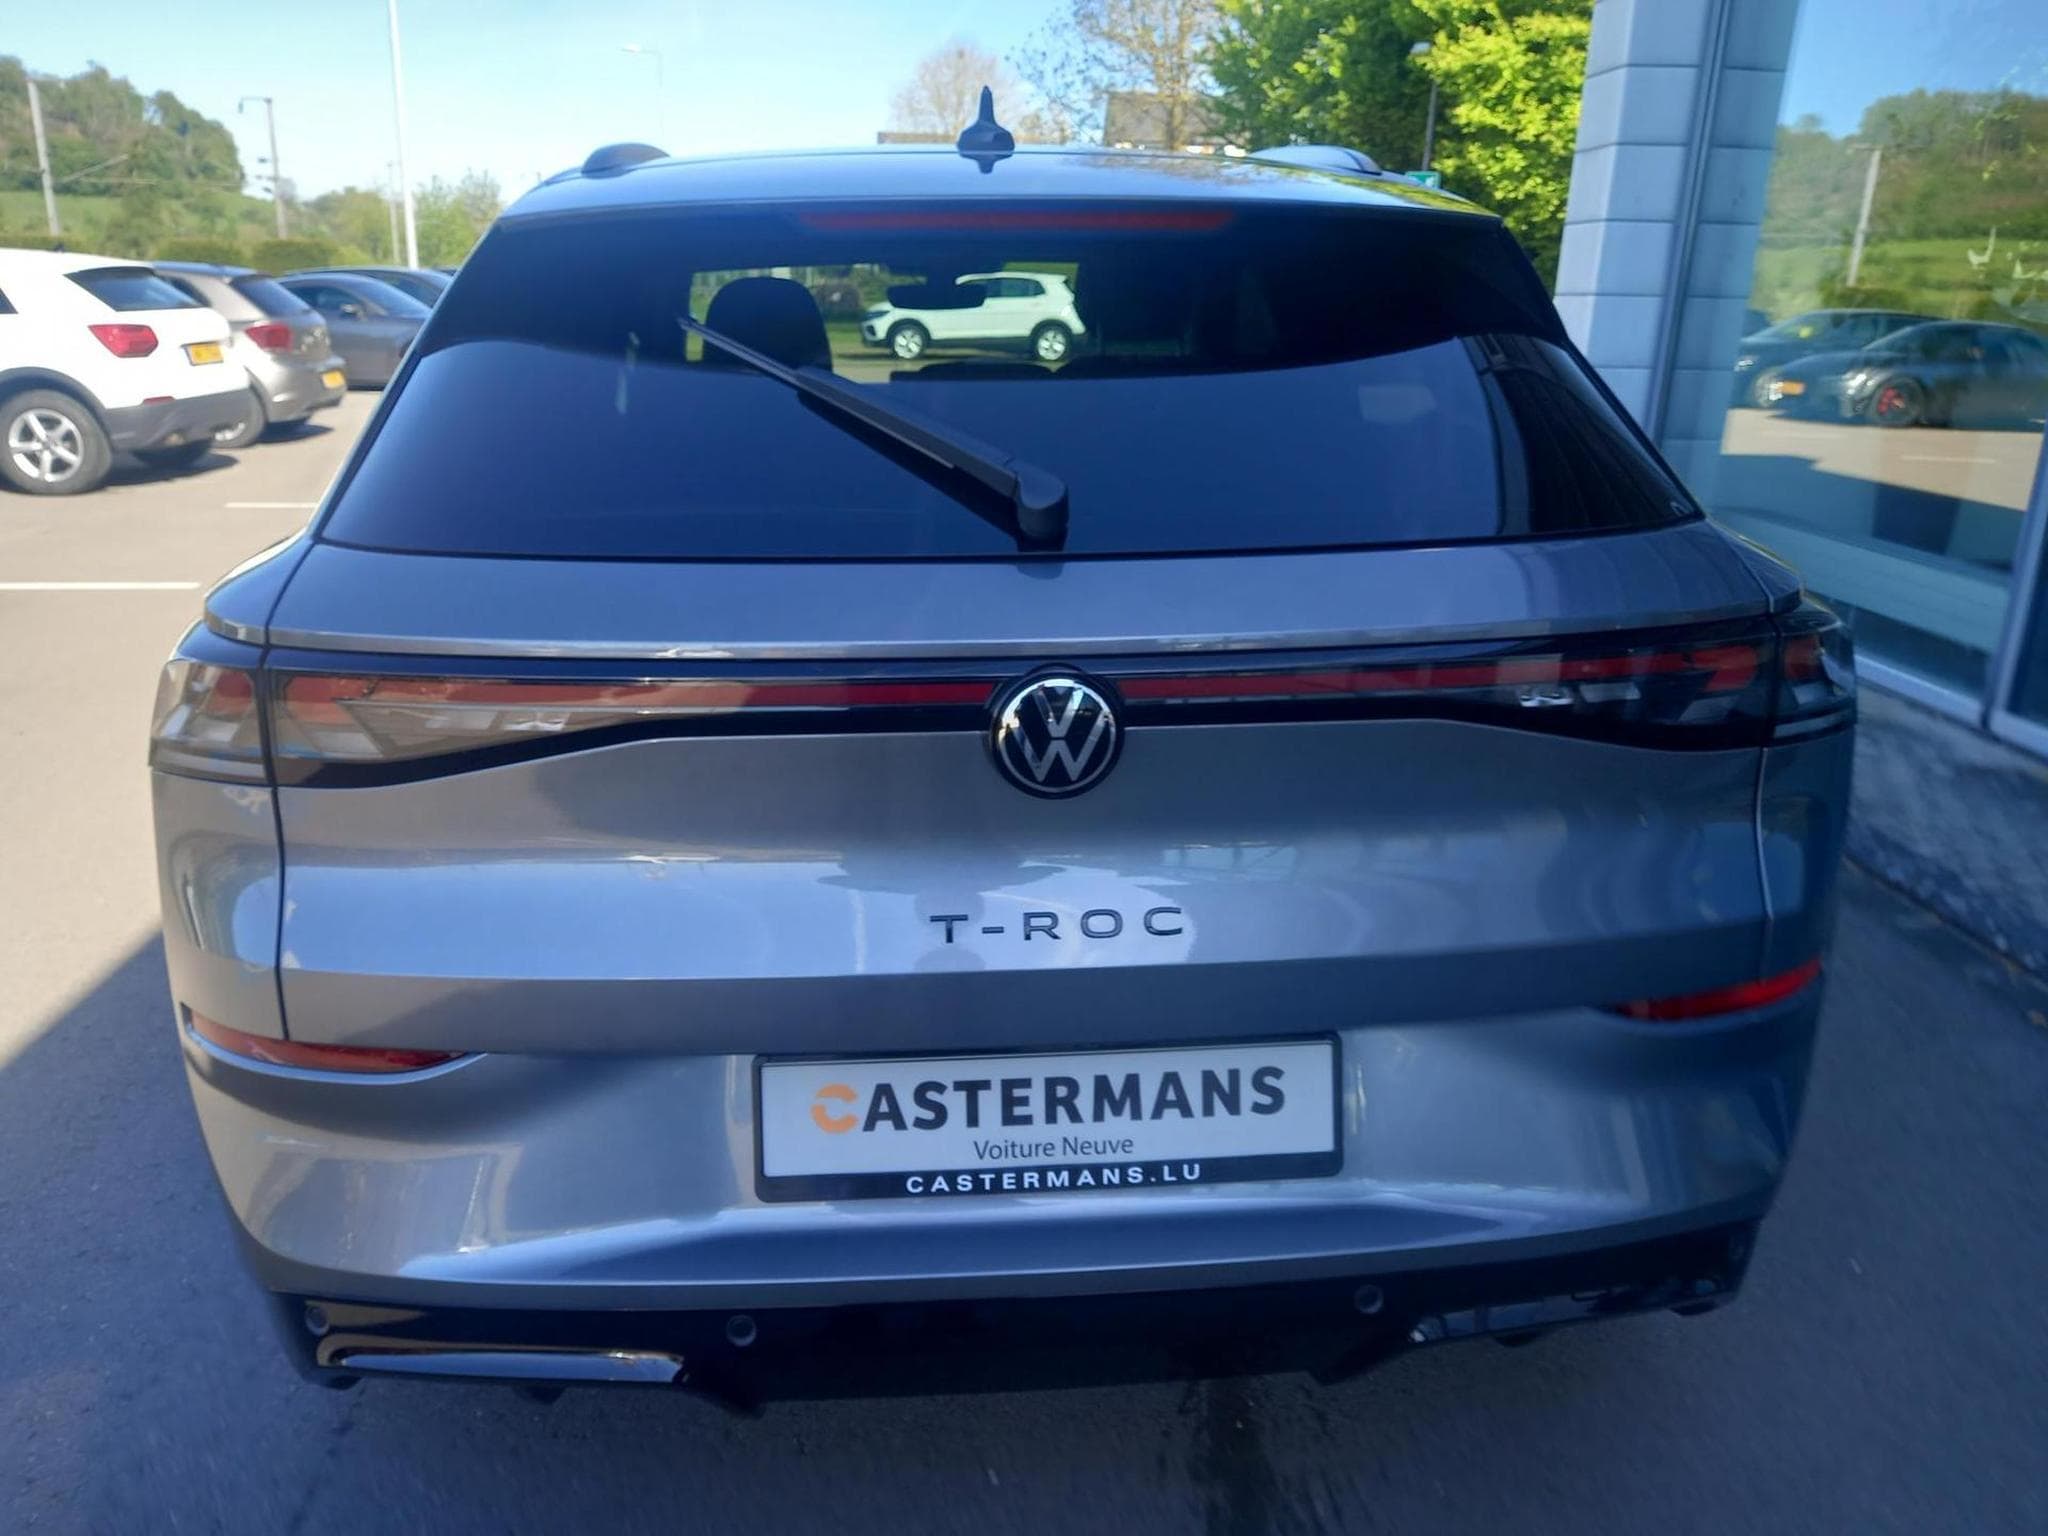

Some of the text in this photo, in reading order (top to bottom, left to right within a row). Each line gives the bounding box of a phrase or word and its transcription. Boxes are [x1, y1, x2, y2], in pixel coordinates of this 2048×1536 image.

[1001, 683, 1113, 784] VW
[929, 906, 1184, 944] T-ROC
[811, 1065, 1287, 1135] CASTERMANS
[973, 1135, 1135, 1161] Voiture Neuve
[905, 1162, 1202, 1194] CASTERMANS.LU
